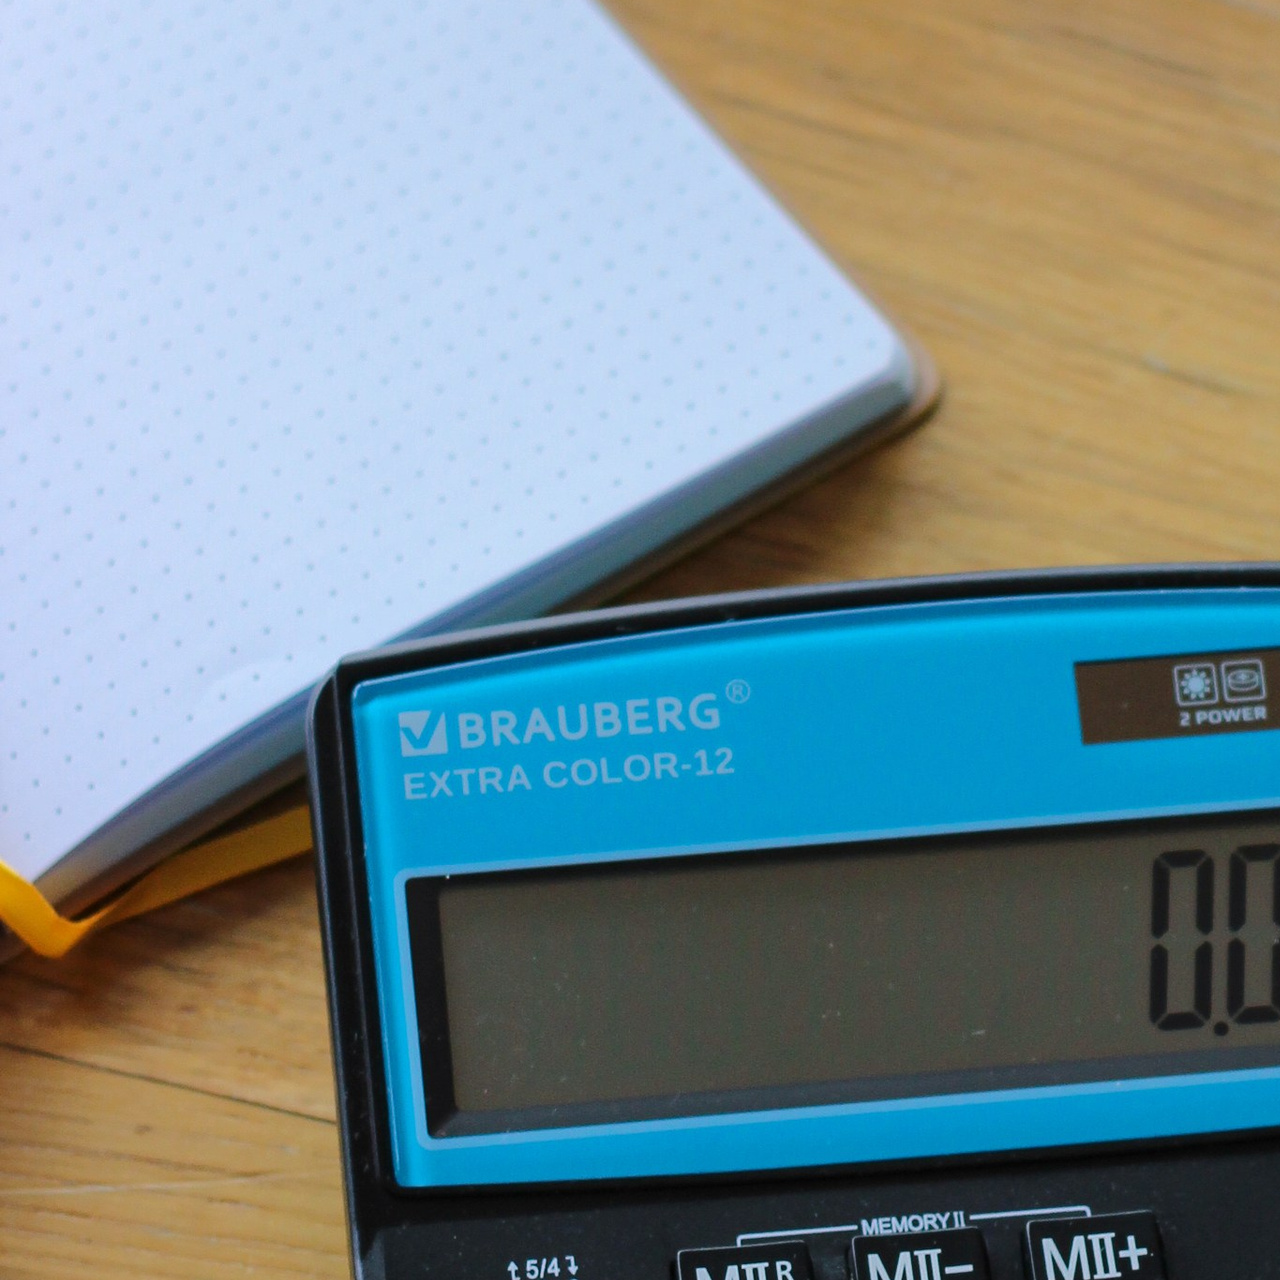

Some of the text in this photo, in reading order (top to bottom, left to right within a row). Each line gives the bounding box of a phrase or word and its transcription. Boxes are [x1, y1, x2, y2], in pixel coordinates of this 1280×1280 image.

[1179, 706, 1268, 727] 2 POWER
[403, 747, 735, 800] EXTRA COLOR-12
[860, 1211, 951, 1237] MEMORY
[525, 1257, 561, 1280] 5/4
